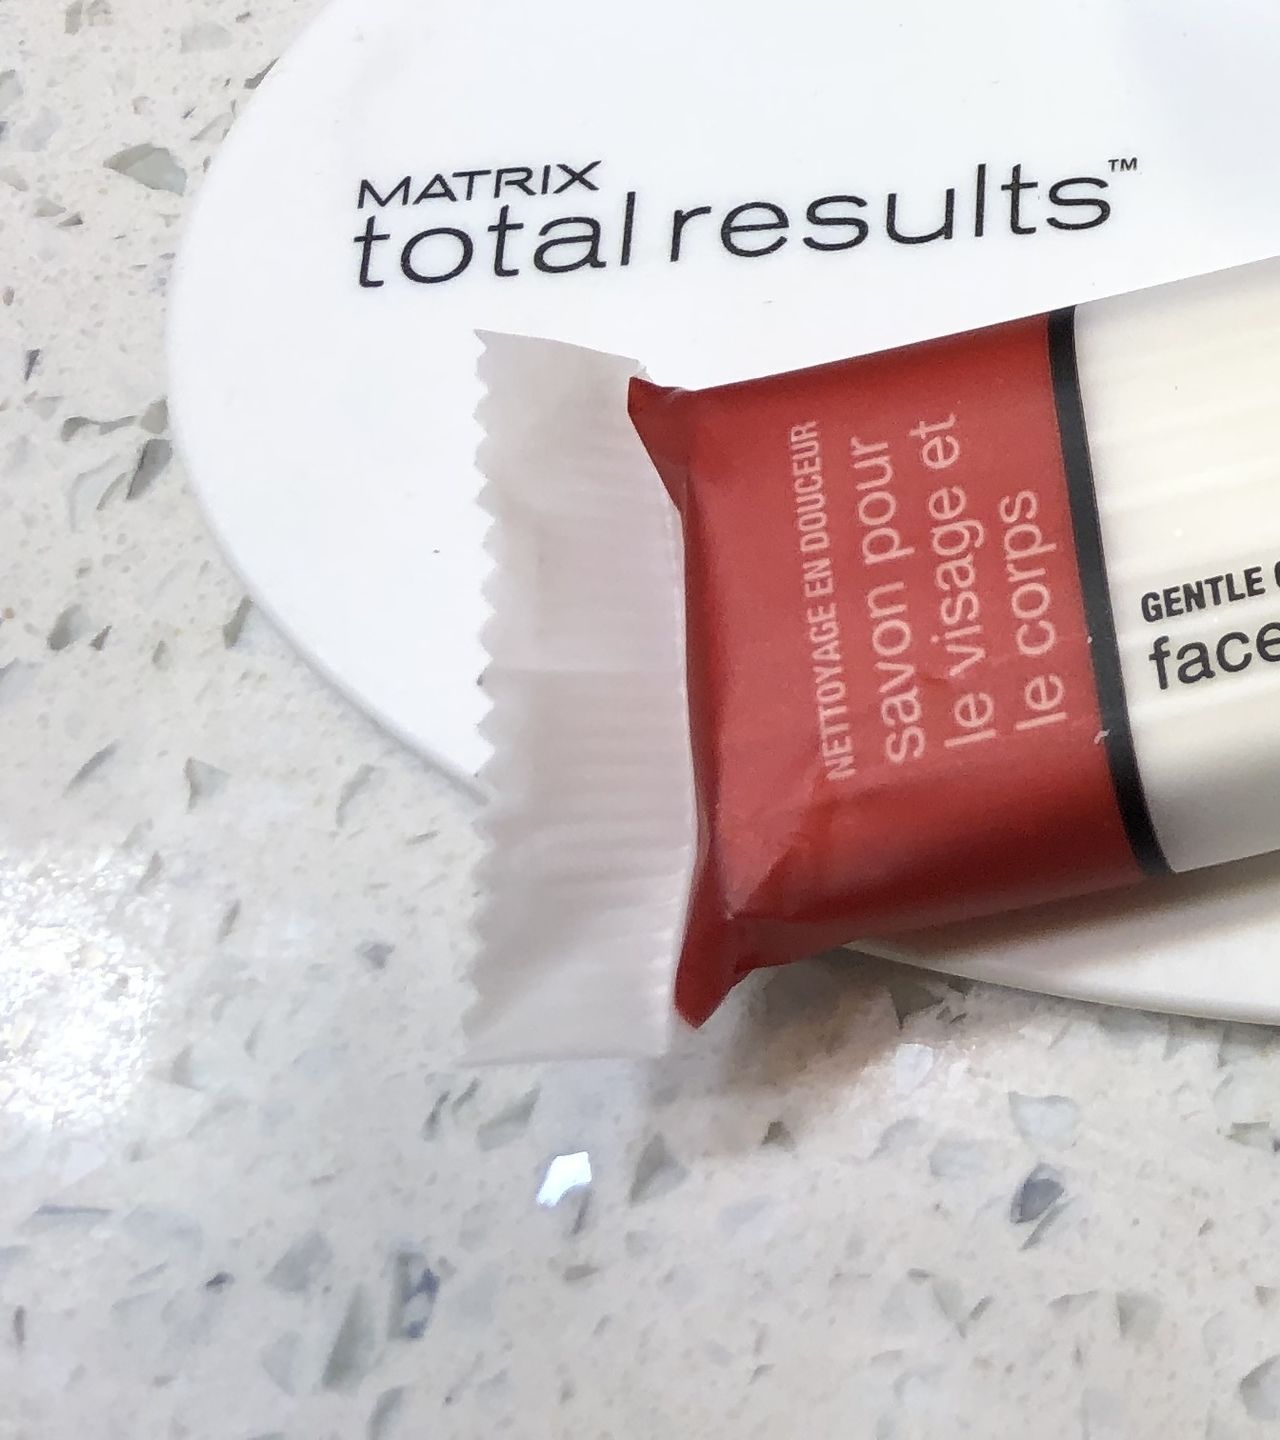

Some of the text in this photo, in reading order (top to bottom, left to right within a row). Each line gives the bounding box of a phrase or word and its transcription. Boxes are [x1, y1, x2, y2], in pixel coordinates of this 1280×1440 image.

[354, 192, 637, 288] total
[357, 160, 602, 208] MATRIX
[791, 420, 857, 780] NETTOYAGE EN DOUCEUR
[850, 436, 926, 765] savon pour
[909, 412, 998, 748] le visage et
[1000, 489, 1068, 732] le corps
[1141, 565, 1265, 622] GENTLE
